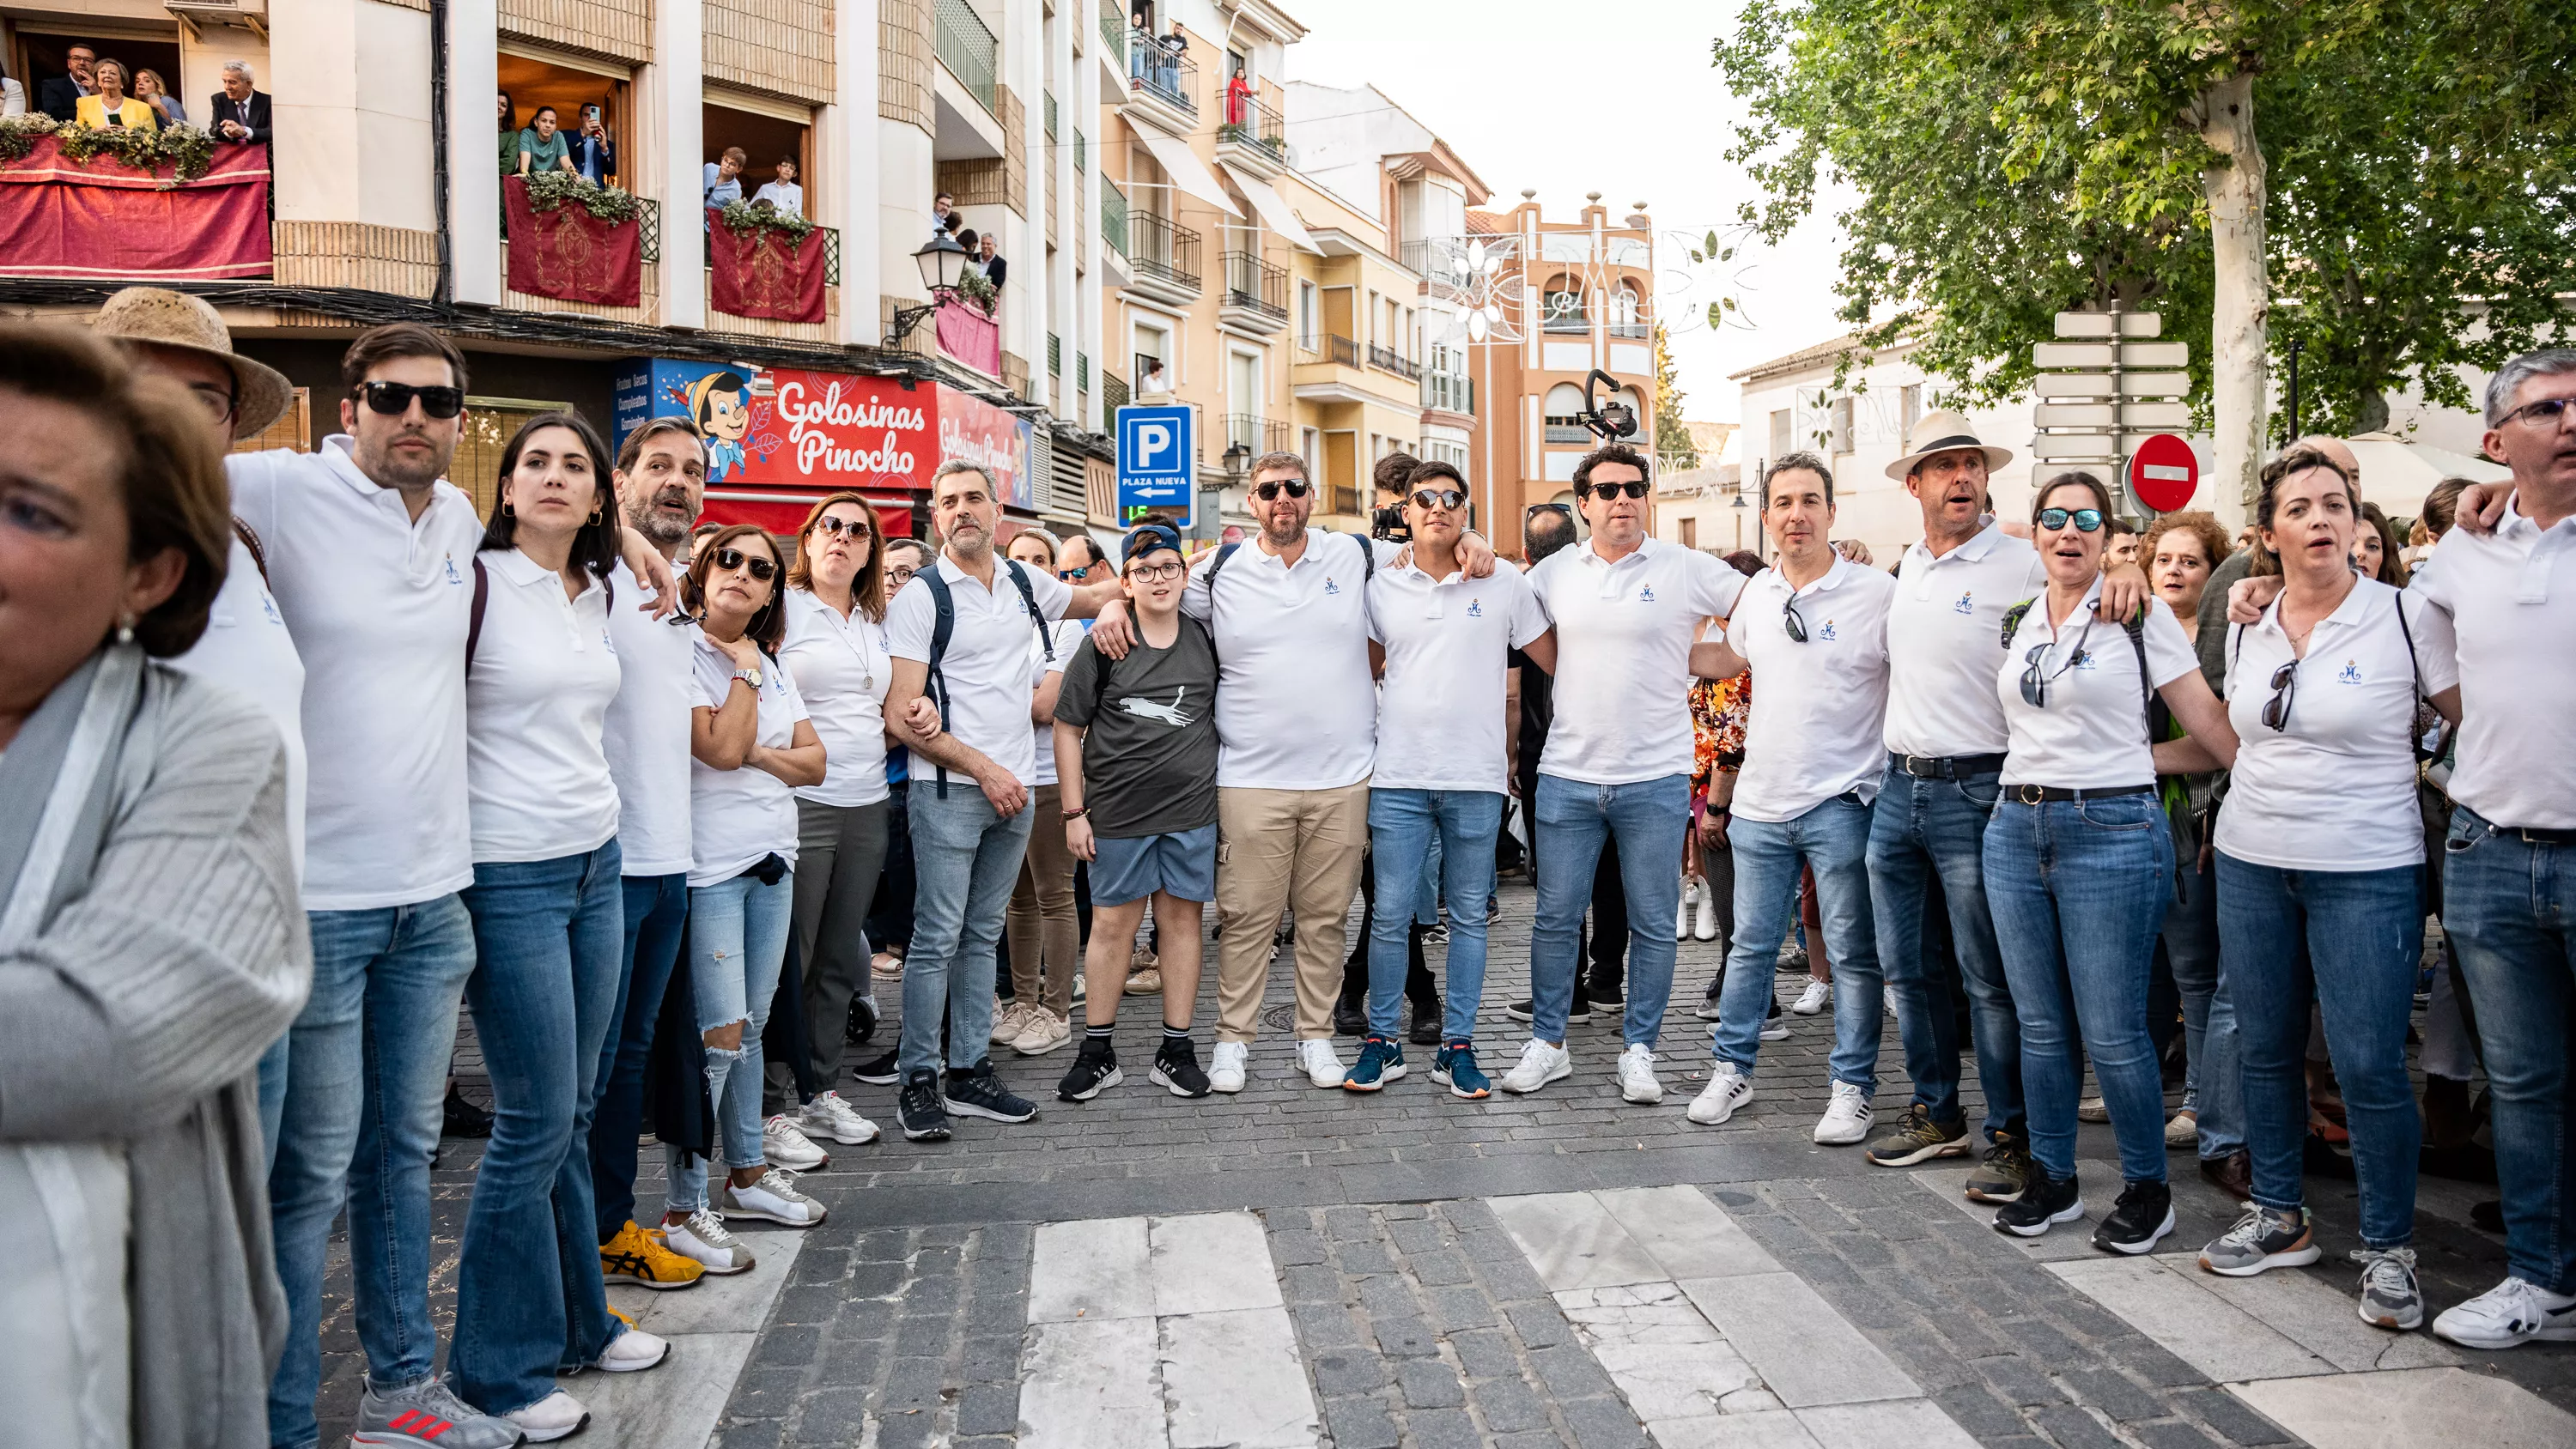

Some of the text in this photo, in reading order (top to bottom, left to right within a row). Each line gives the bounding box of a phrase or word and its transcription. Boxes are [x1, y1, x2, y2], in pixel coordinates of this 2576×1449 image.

[633, 374, 647, 387] Secos
[618, 395, 647, 412] Cumpleaños
[777, 380, 926, 444] Golosinas
[797, 430, 914, 475] Pinocho
[939, 416, 983, 464] Golosinas
[1139, 424, 1170, 467] P
[1122, 476, 1187, 486] PLAZA NUEVA
